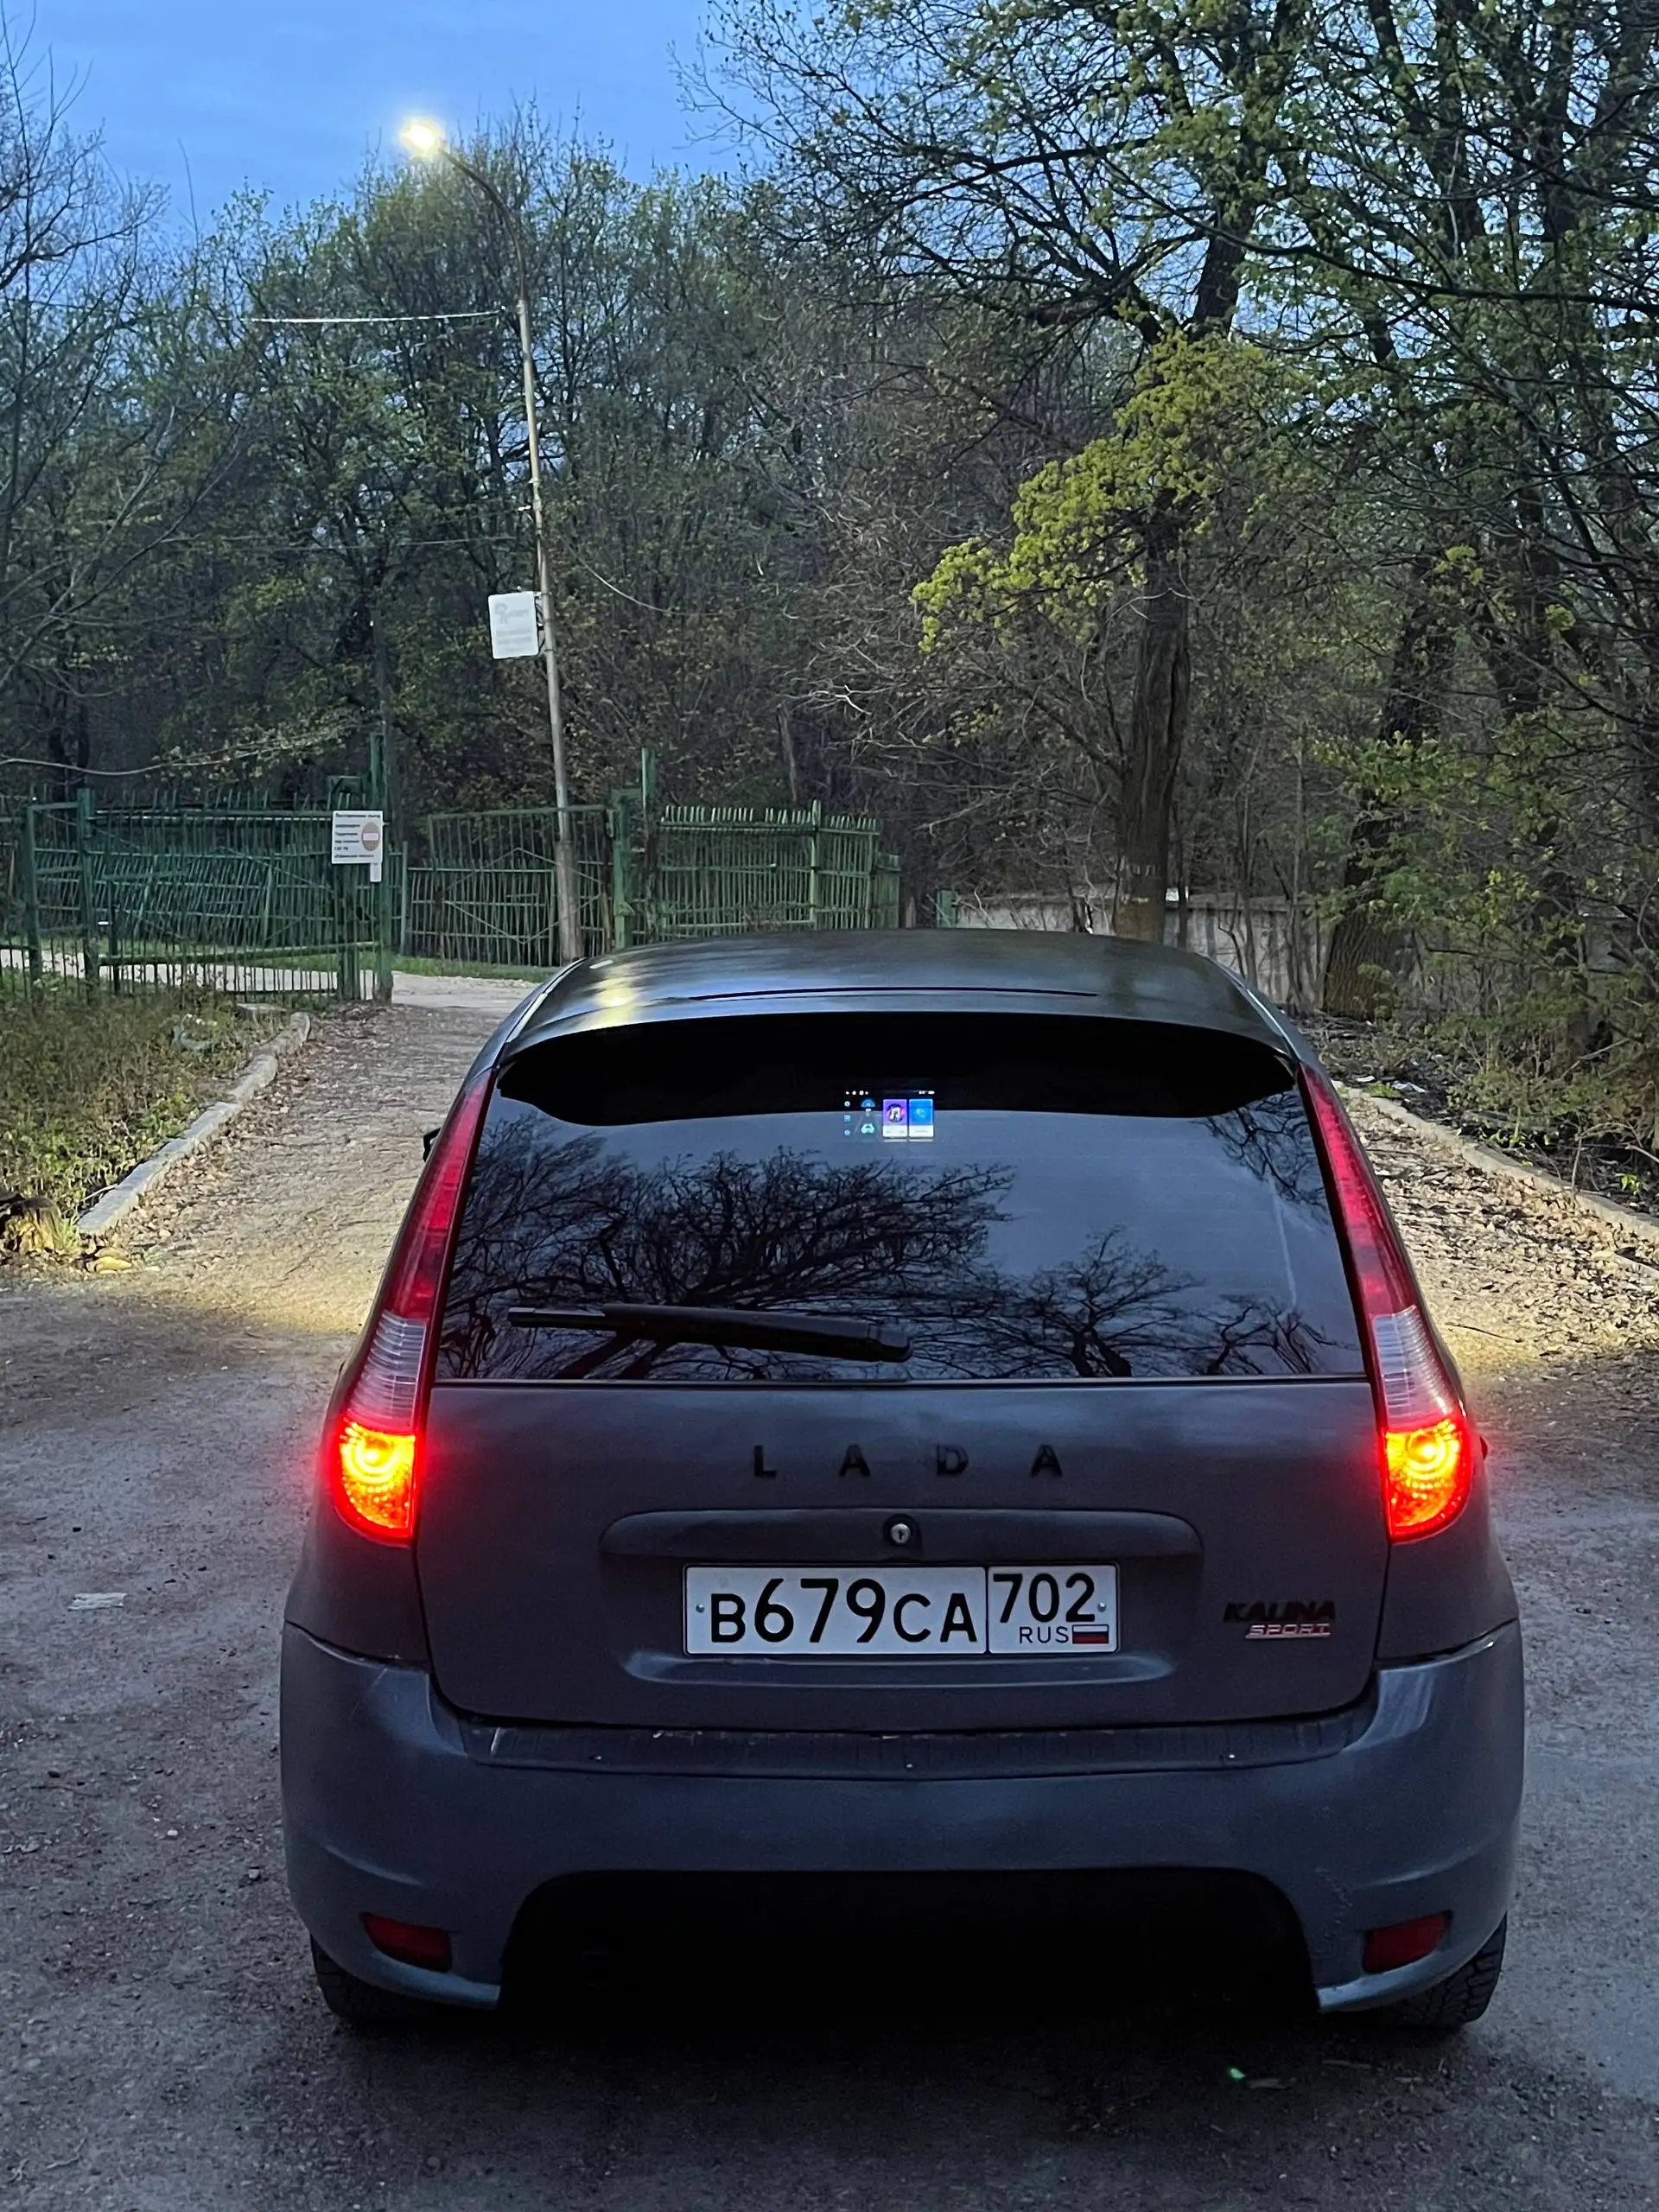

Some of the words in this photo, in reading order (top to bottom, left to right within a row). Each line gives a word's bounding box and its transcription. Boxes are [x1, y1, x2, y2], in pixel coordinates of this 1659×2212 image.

[753, 1444, 1063, 1478] LADA
[992, 1572, 1096, 1624] 702
[1223, 1600, 1337, 1623] KALINA
[1019, 1625, 1070, 1644] RUS
[1248, 1623, 1332, 1636] SPORT
